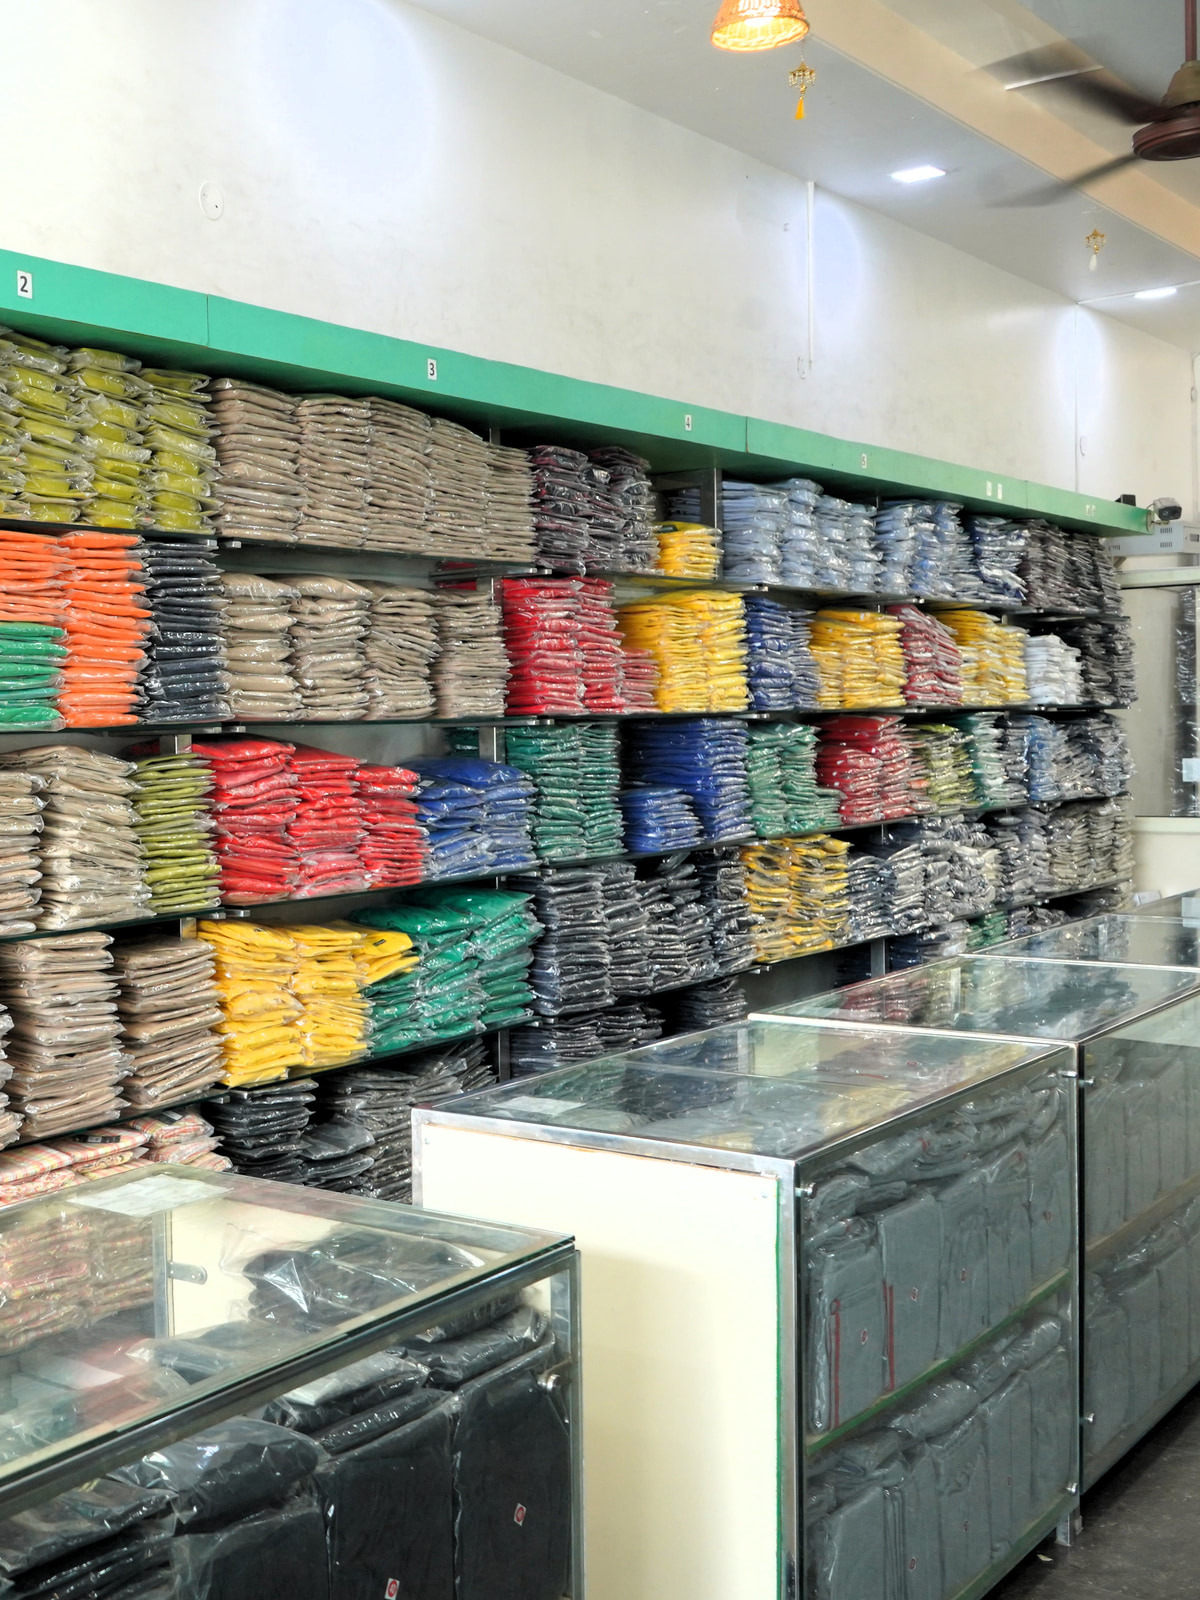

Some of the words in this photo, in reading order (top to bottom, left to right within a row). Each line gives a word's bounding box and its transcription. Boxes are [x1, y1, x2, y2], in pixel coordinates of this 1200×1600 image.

[19, 275, 29, 294] 2
[429, 361, 435, 377] 3
[685, 415, 691, 429] 4
